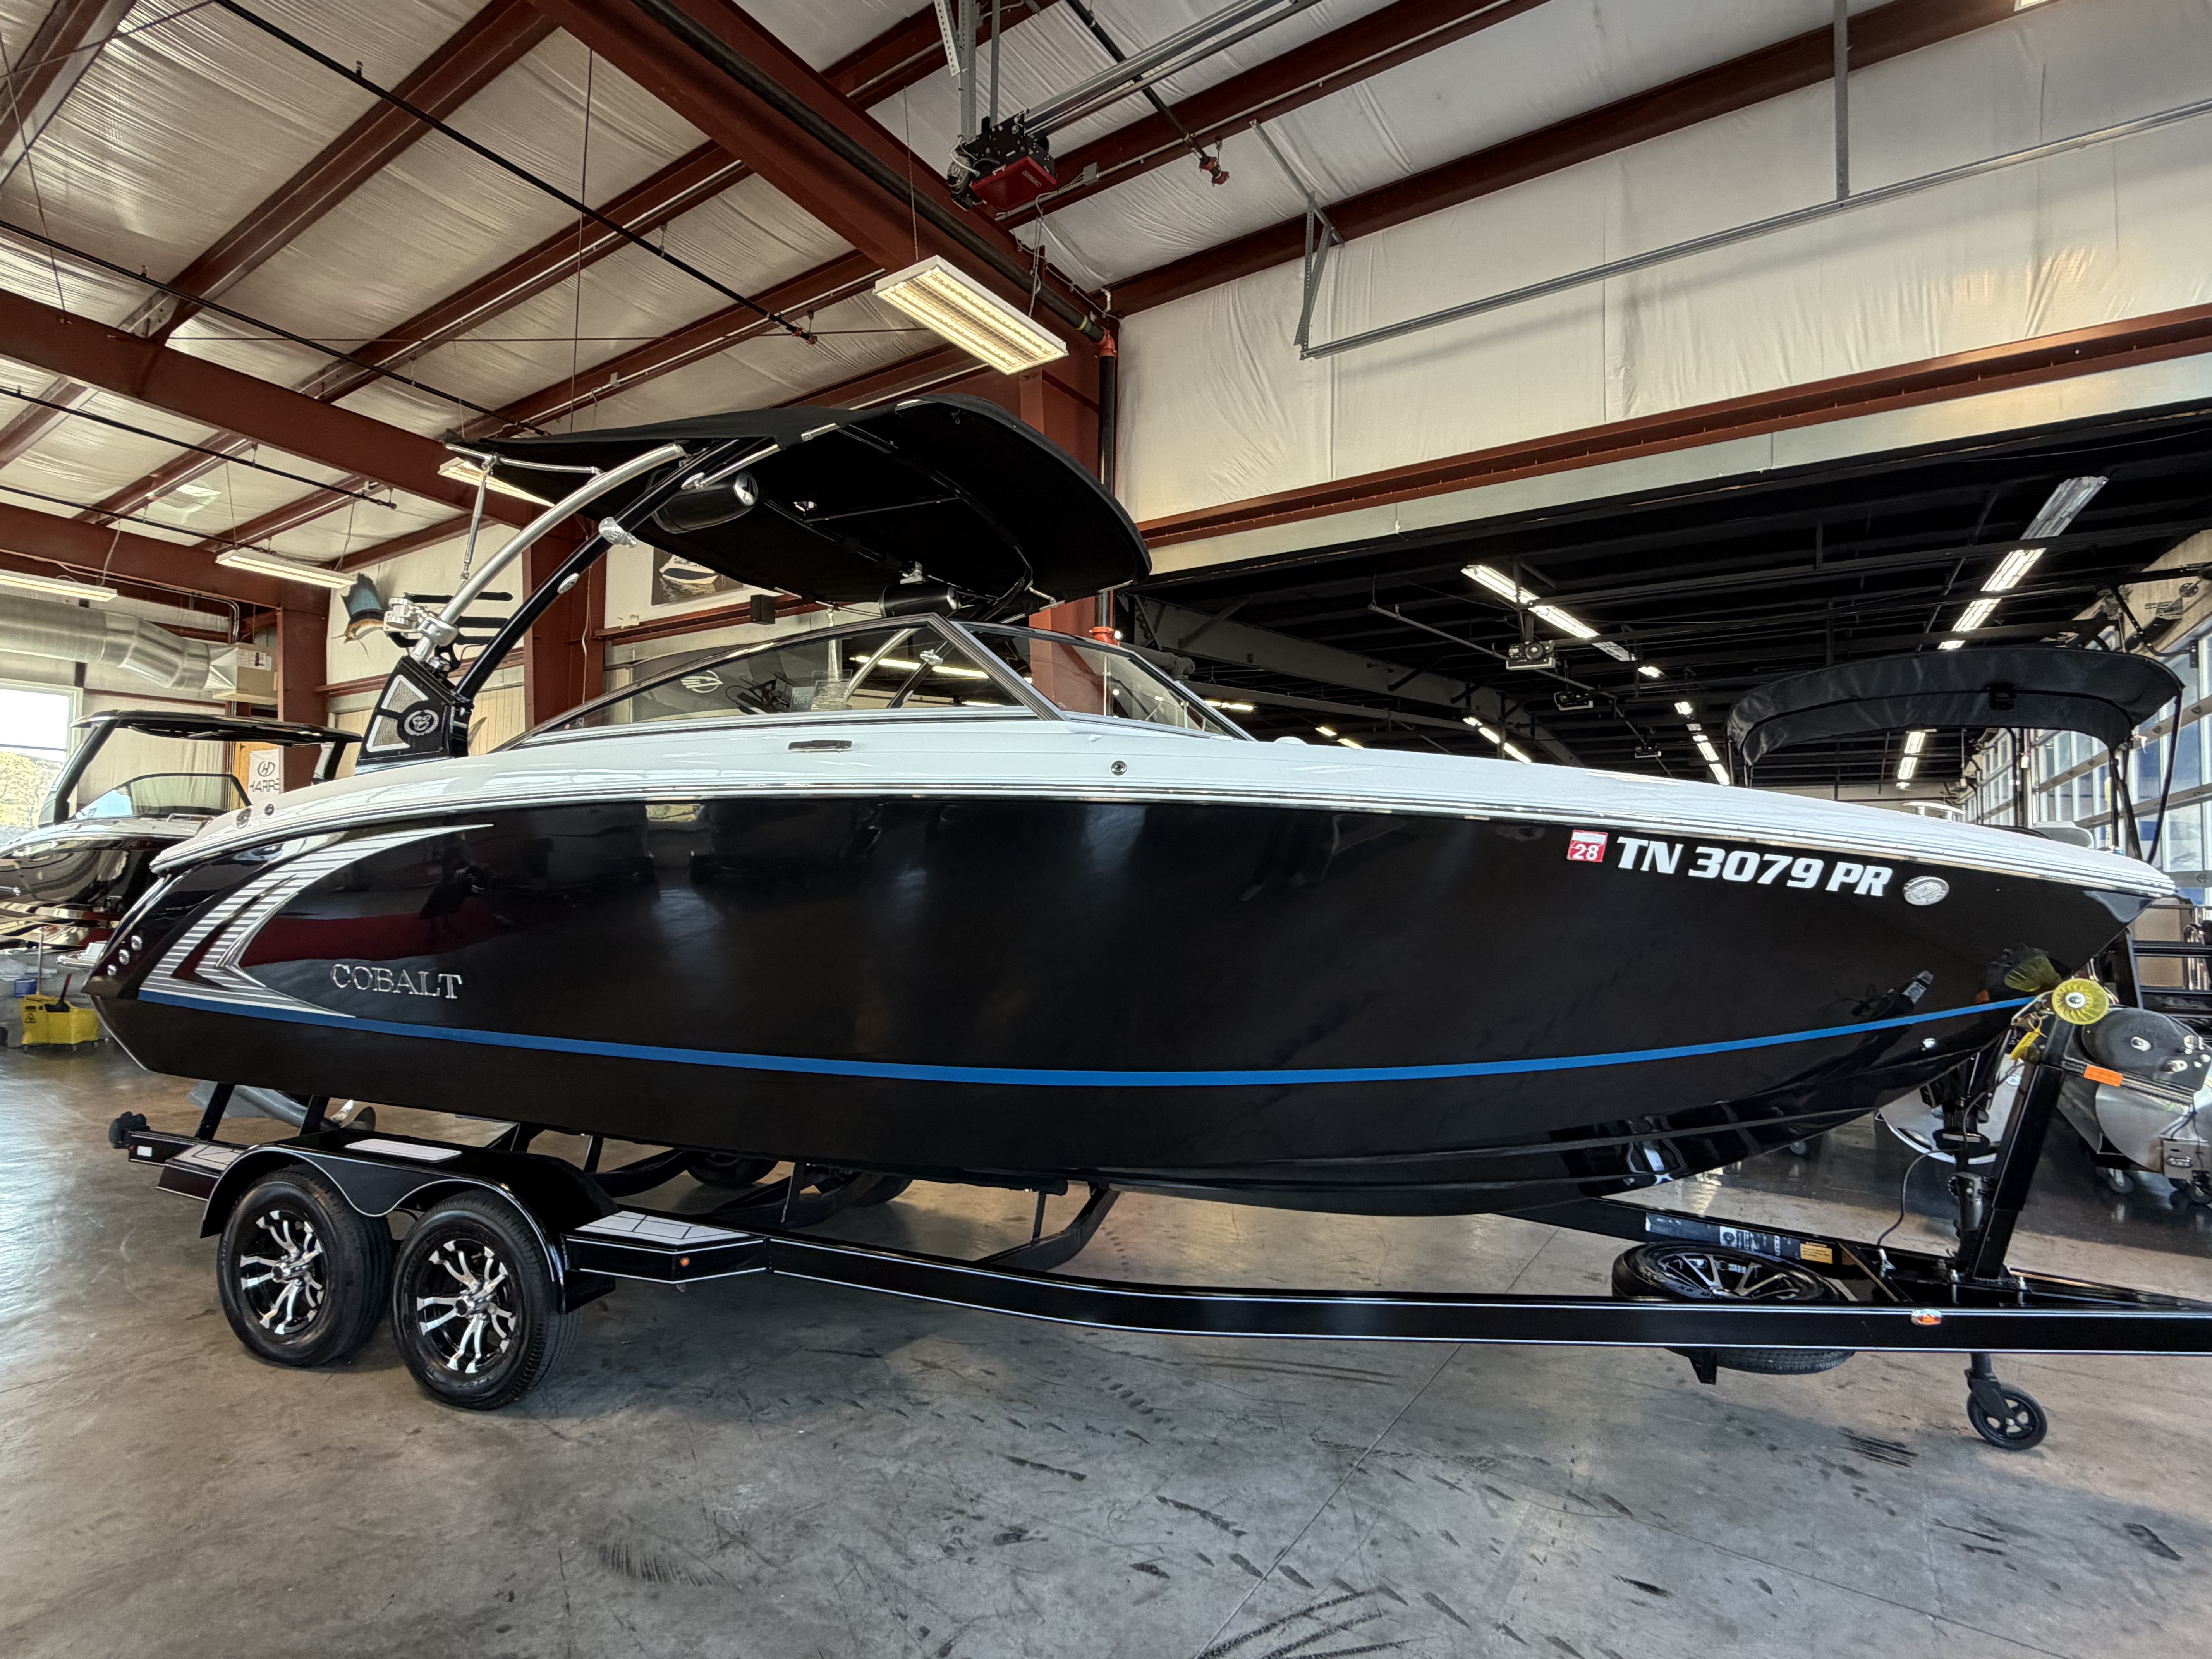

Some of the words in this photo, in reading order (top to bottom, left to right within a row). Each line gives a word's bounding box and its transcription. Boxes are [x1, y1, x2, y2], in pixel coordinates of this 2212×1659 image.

[1572, 843, 1599, 861] 28
[1616, 836, 1684, 874] TN
[1687, 846, 1825, 889] 3079
[1825, 861, 1893, 897] PR
[330, 963, 462, 999] COBALT
